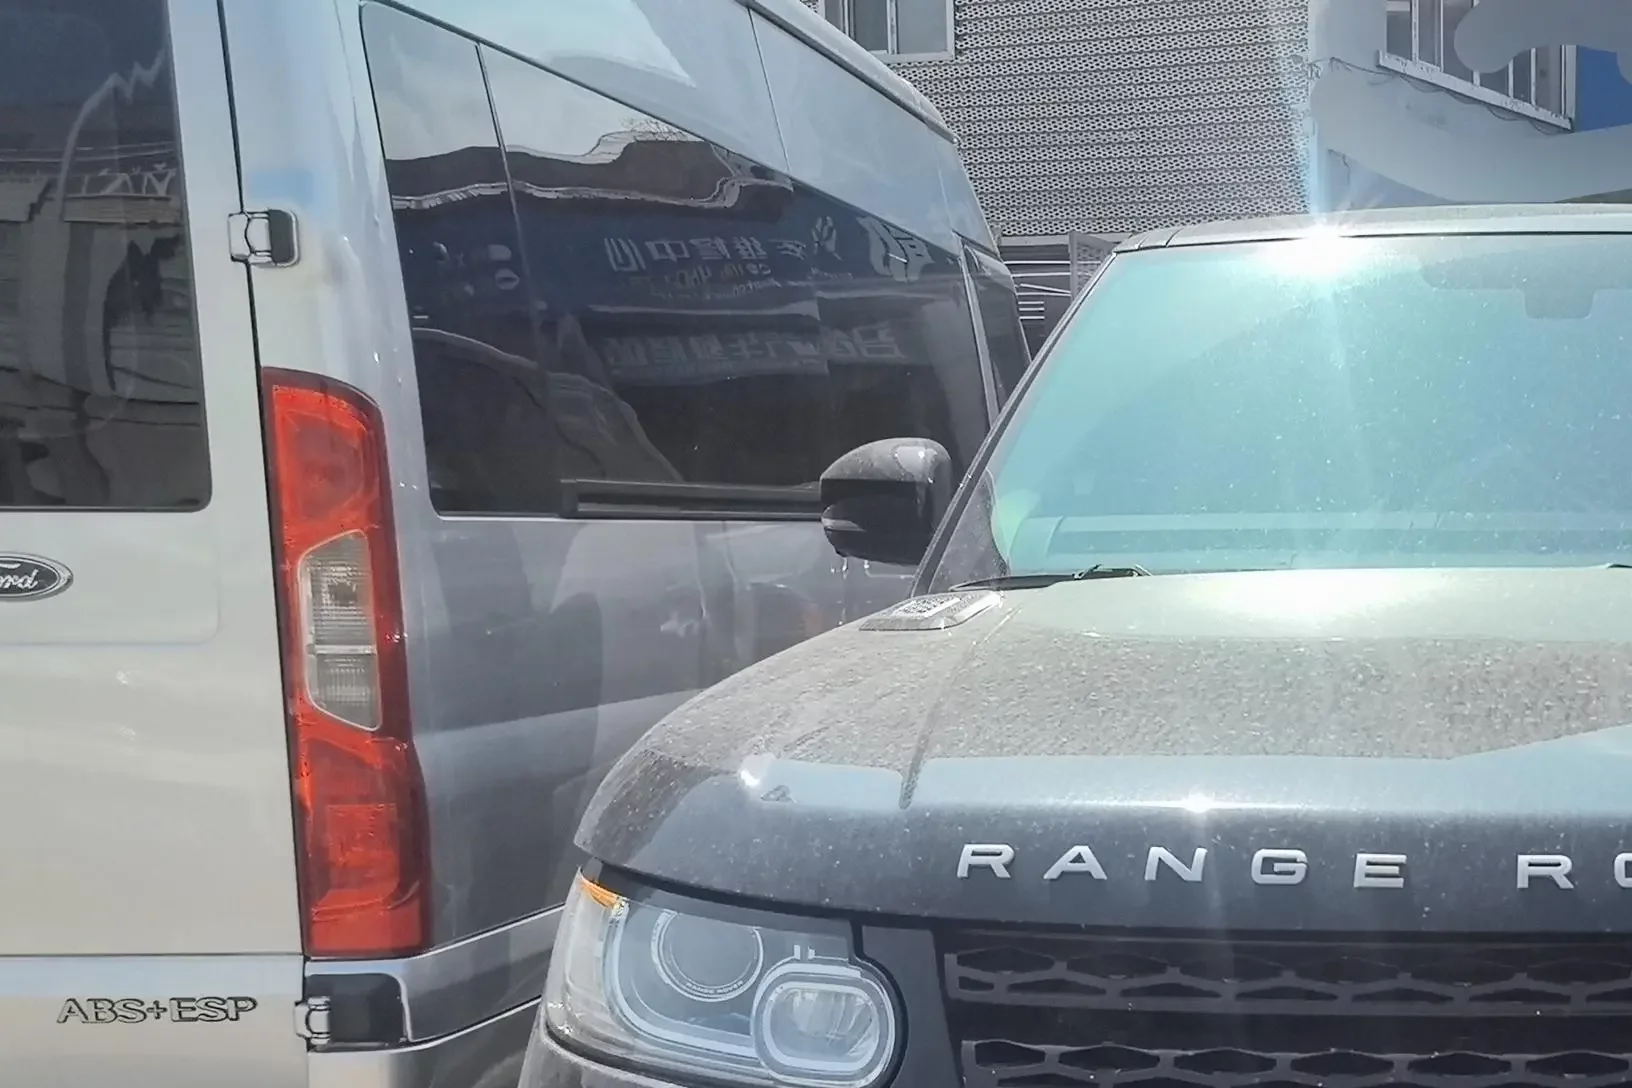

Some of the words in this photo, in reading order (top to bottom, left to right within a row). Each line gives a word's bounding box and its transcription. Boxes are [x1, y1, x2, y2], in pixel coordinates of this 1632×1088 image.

[0, 563, 39, 590] ord
[956, 843, 1408, 888] RANGE
[57, 996, 258, 1025] ABS+ESP
